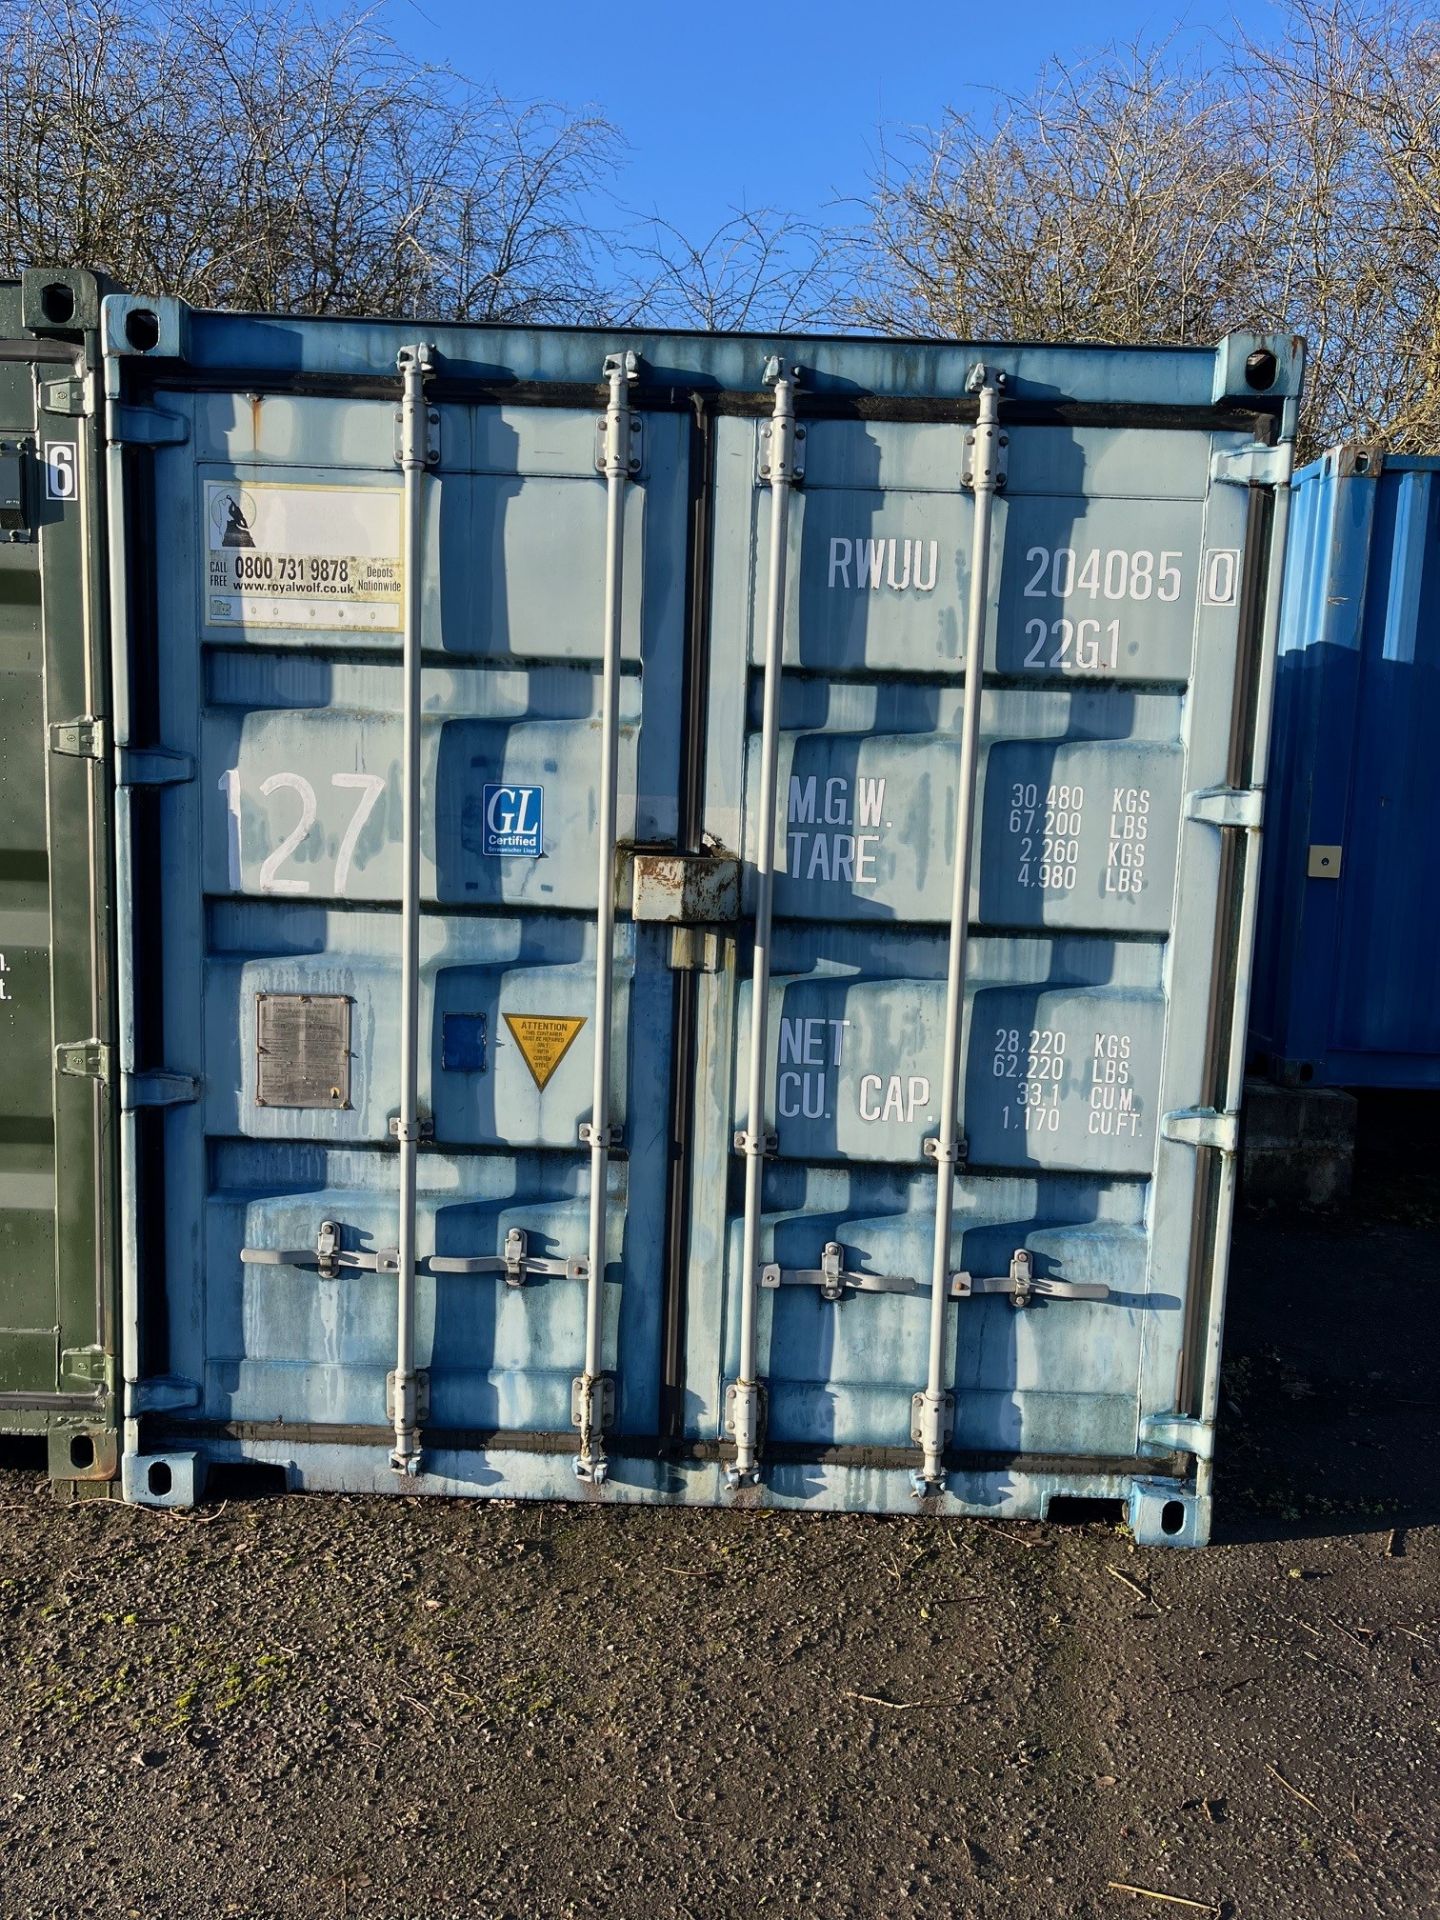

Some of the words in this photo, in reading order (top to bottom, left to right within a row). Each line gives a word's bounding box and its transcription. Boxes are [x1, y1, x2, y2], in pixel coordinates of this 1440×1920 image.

[49, 445, 73, 497] 6
[209, 574, 227, 586] FREE
[210, 561, 228, 573] CALL
[235, 556, 272, 579] 0800
[278, 558, 304, 580] 731
[311, 559, 348, 582] 9878
[366, 566, 393, 579] Depots
[828, 537, 938, 591] RWUU
[1023, 546, 1183, 602] 204085
[1209, 552, 1234, 602] 0
[233, 581, 354, 594] www.royalwolf.co.uk
[358, 580, 401, 592] Nationwide
[1023, 618, 1121, 670] 22G1
[487, 788, 538, 834] GL
[788, 775, 893, 828] M.G.W.
[1011, 783, 1084, 810] 30,480
[1112, 788, 1150, 814] KGS
[218, 768, 386, 895] 127
[488, 834, 536, 846] Certified
[1009, 810, 1082, 836] 67,200
[1109, 814, 1148, 840] LBS
[787, 832, 880, 884] TARE
[1019, 838, 1079, 863] 2,260
[1107, 841, 1145, 868] KGS
[1018, 863, 1077, 889] 4,980
[1105, 868, 1143, 893] LBS
[521, 1022, 568, 1031] ATTENTION
[779, 1018, 851, 1067] NET
[994, 1029, 1066, 1055] 28,220
[1094, 1034, 1131, 1059] KGS
[993, 1054, 1064, 1080] 62,220
[1092, 1059, 1129, 1085] LBS
[778, 1071, 831, 1120] CU.
[859, 1074, 933, 1124] CAP.
[1016, 1082, 1059, 1107] 33.1
[1091, 1086, 1136, 1112] CU.M.
[1002, 1106, 1060, 1131] 1,170
[1088, 1111, 1143, 1138] CU.FT.
